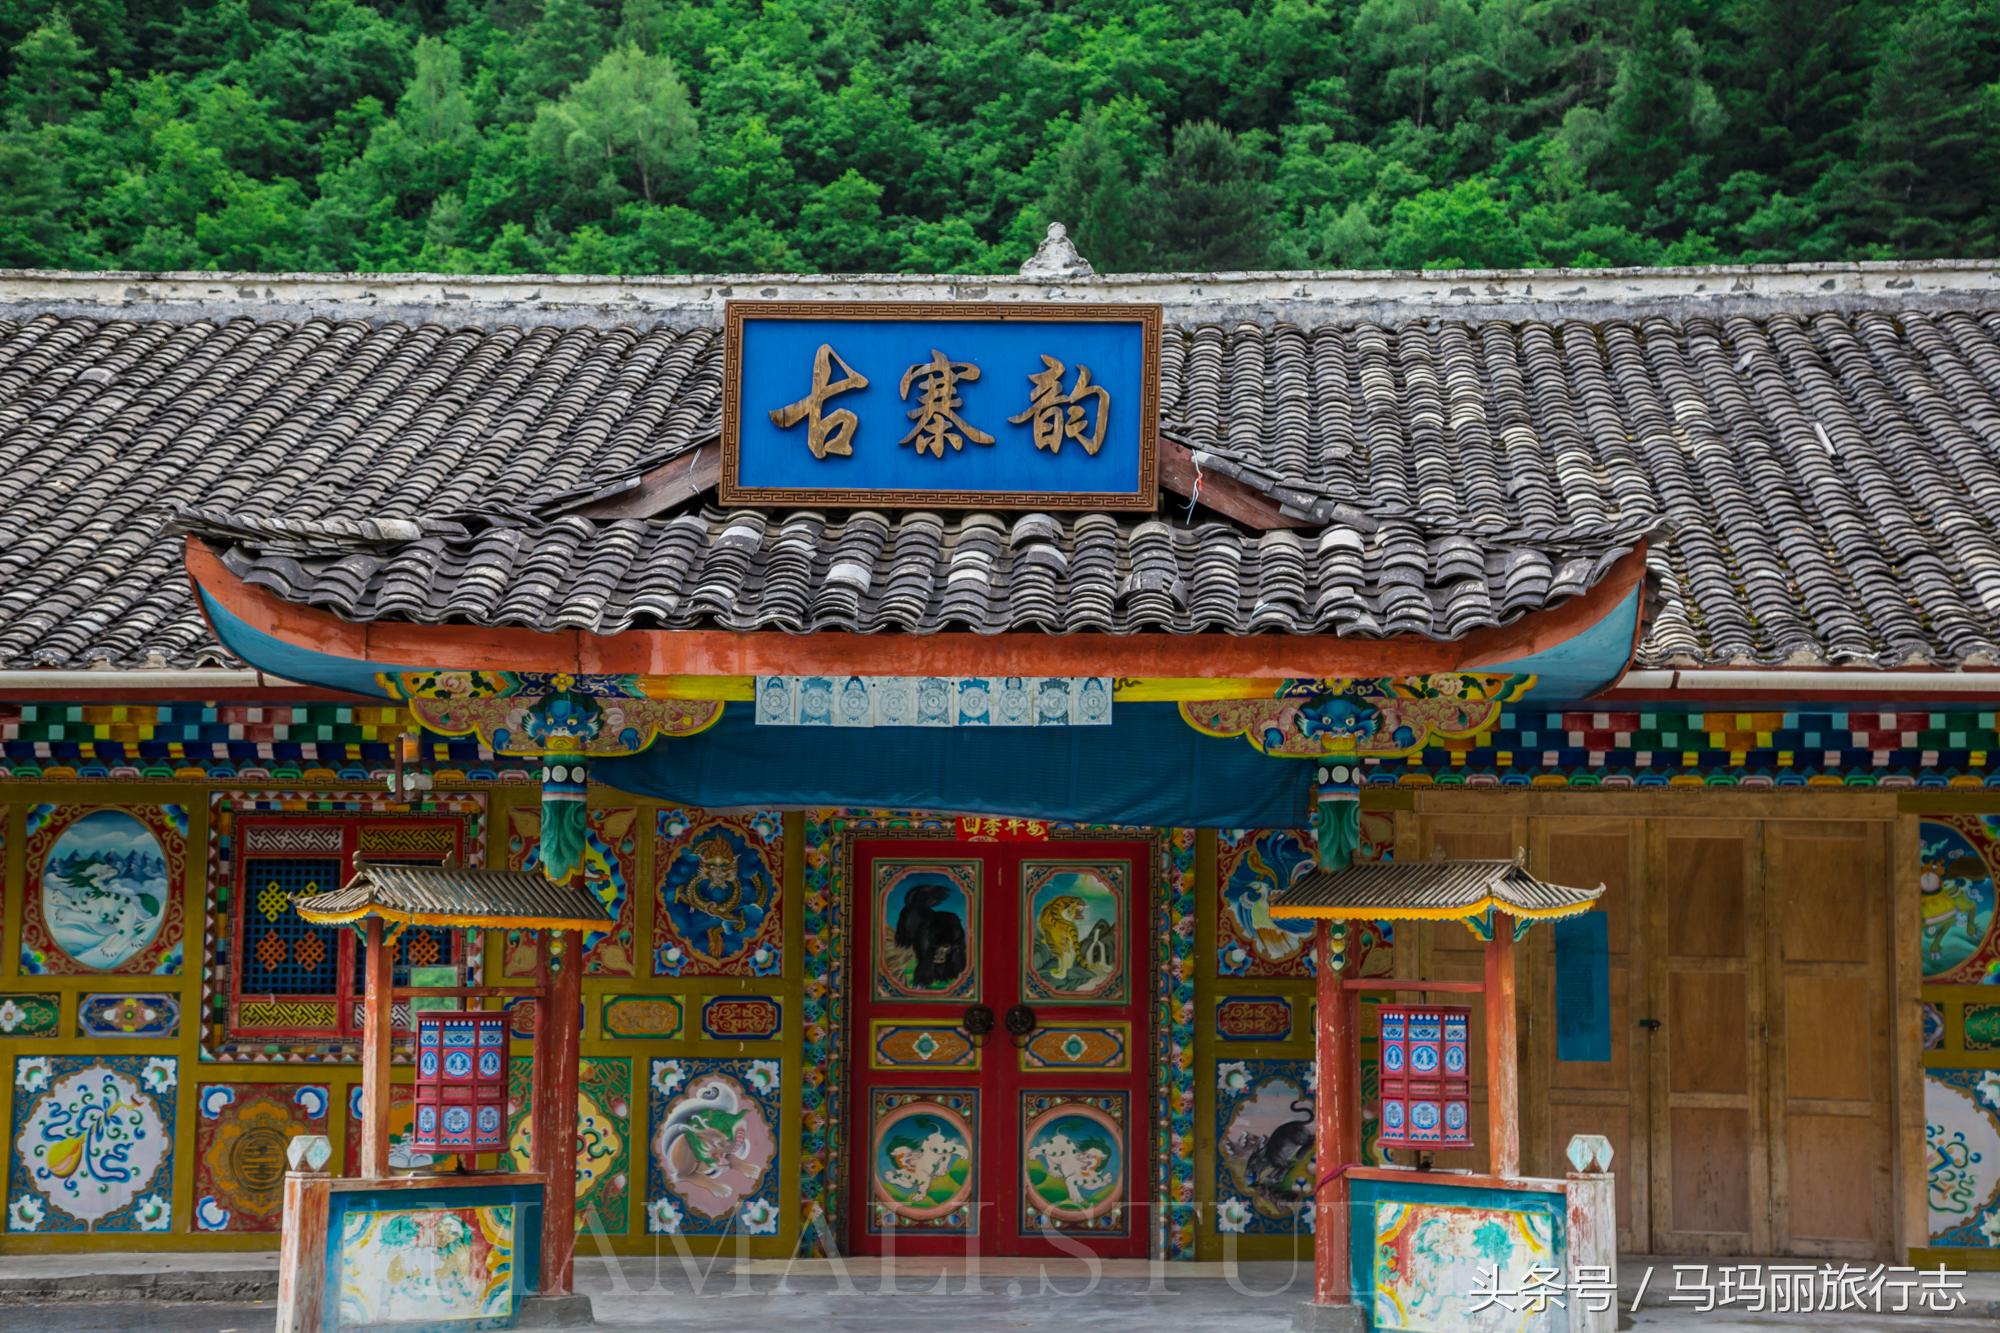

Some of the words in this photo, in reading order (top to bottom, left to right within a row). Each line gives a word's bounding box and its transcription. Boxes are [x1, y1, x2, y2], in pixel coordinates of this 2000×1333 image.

[768, 343, 1111, 460] 古寨韵
[963, 817, 1045, 837] 四季平安
